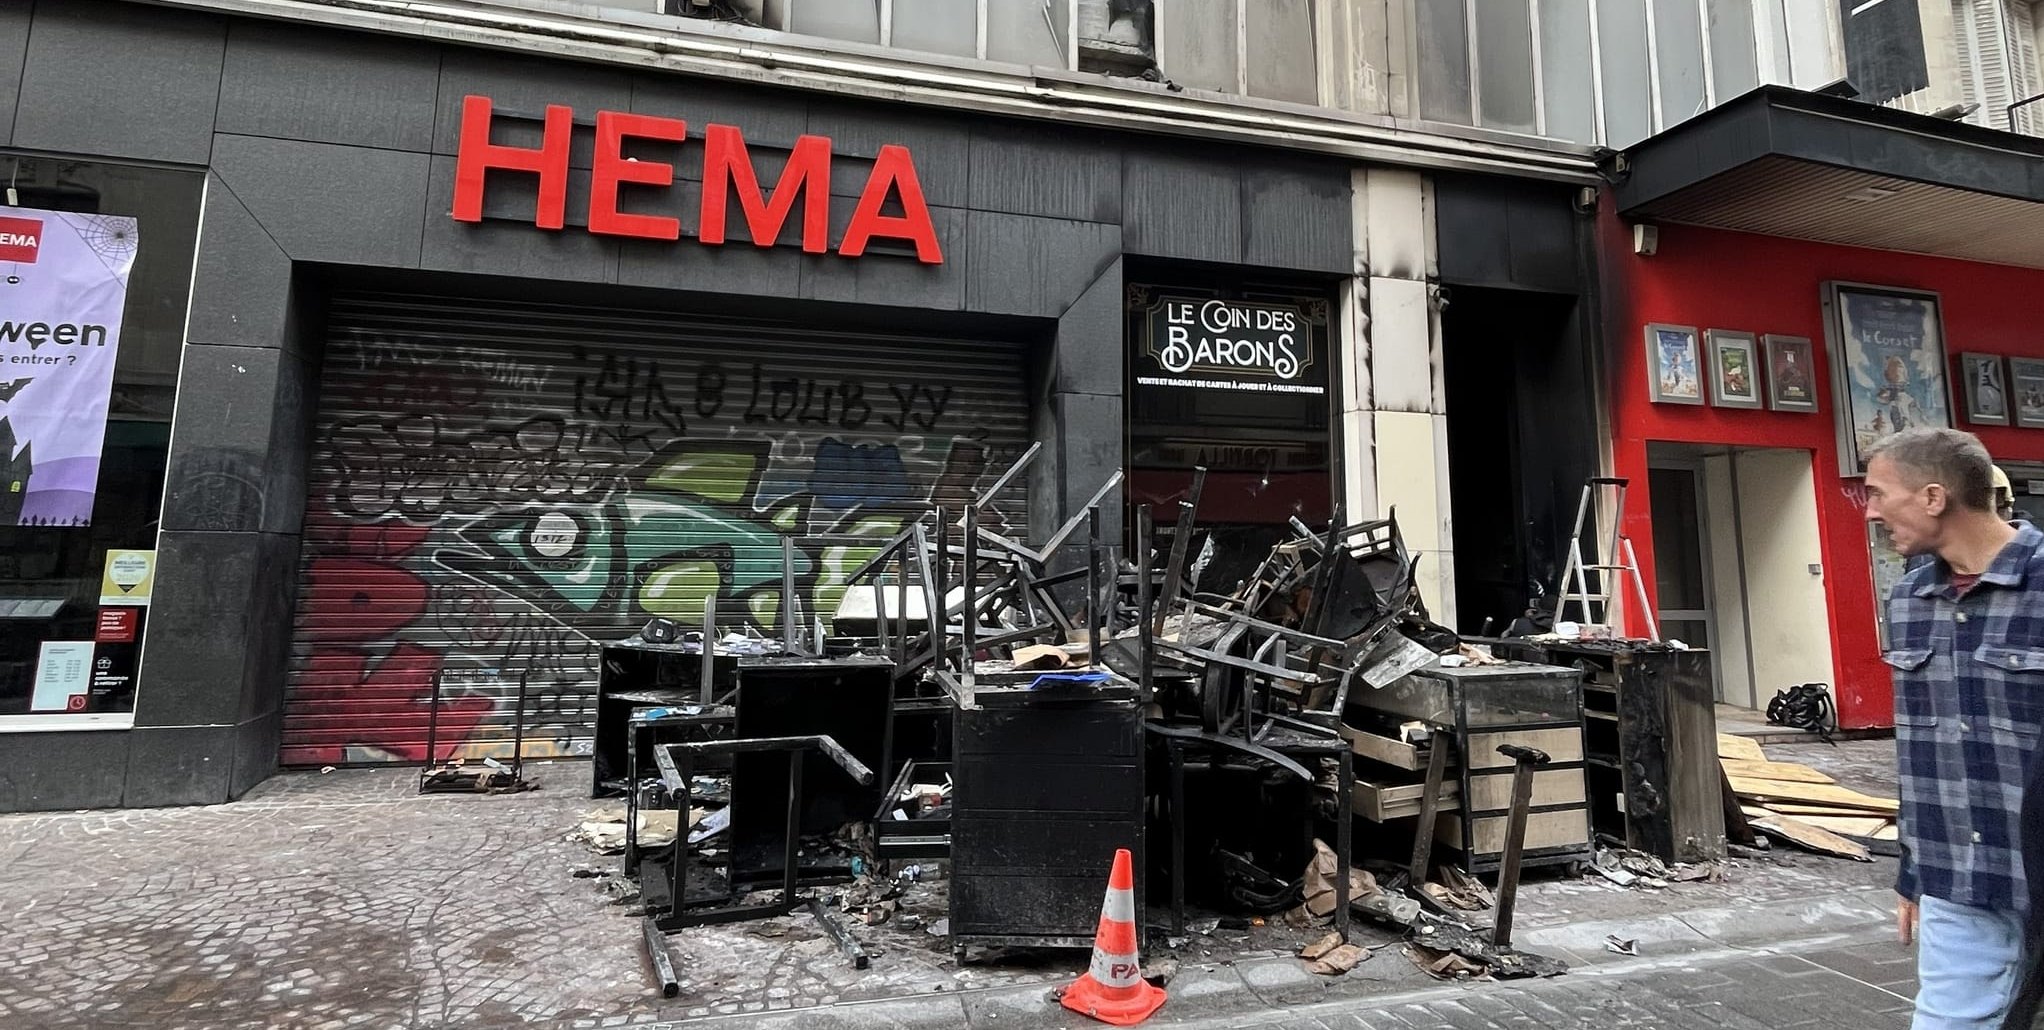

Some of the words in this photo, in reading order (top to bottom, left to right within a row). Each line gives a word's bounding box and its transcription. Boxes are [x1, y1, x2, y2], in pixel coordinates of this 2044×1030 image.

[453, 95, 943, 264] HEMA
[1168, 303, 1195, 325] LE
[1201, 300, 1251, 333] COIN
[1256, 310, 1296, 332] DES
[1161, 326, 1298, 379] BARONS
[1874, 330, 1918, 347] Corset
[11, 353, 61, 365] entrer
[67, 356, 77, 366] ?
